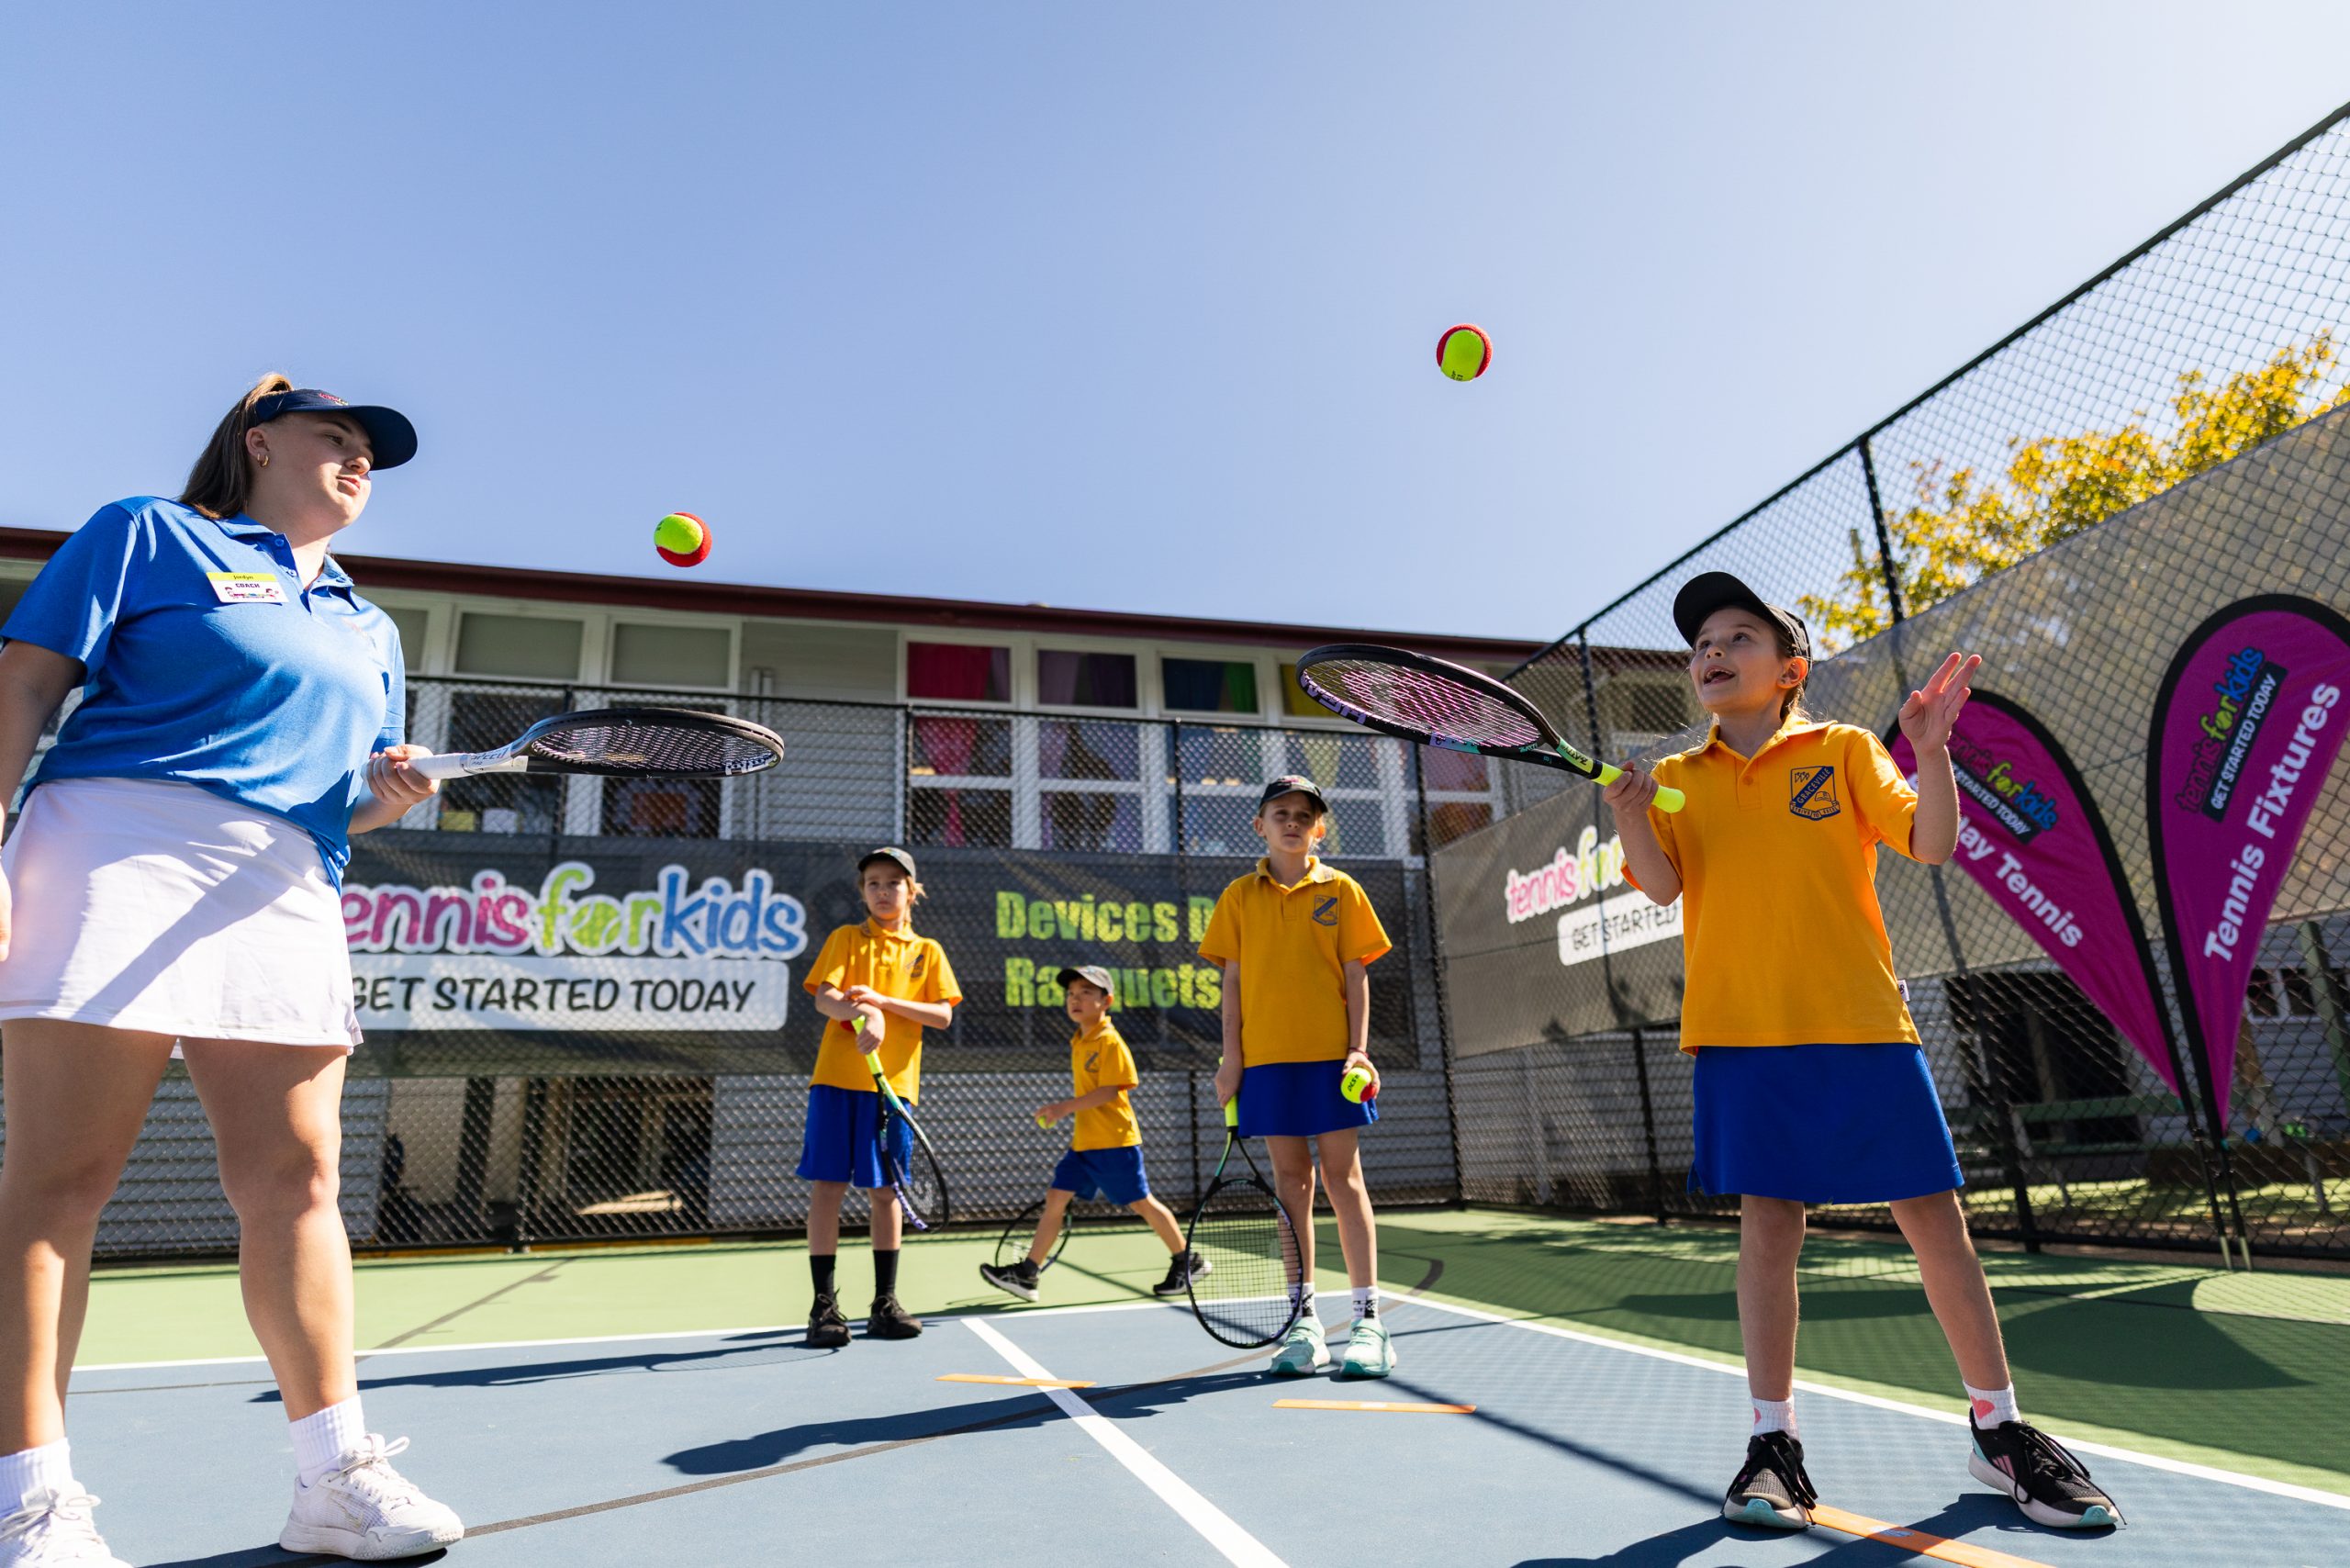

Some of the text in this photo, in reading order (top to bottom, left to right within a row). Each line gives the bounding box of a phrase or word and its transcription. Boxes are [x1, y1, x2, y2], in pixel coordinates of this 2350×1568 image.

[2210, 672, 2277, 811] GET STARTED TODAY
[1796, 767, 1830, 804] GRACEVILLE
[1949, 735, 2057, 831] ennisforkids
[1996, 803, 2032, 837] TODAY
[2203, 682, 2341, 963] Tennis Fixtures
[341, 865, 803, 956] ennisforkids
[996, 890, 1180, 943] Devices
[1572, 904, 1678, 951] GET STARTED
[1995, 851, 2084, 948] Tennis
[432, 978, 621, 1011] STARTED
[631, 979, 756, 1013] TODAY
[1004, 957, 1223, 1013] Rauets
